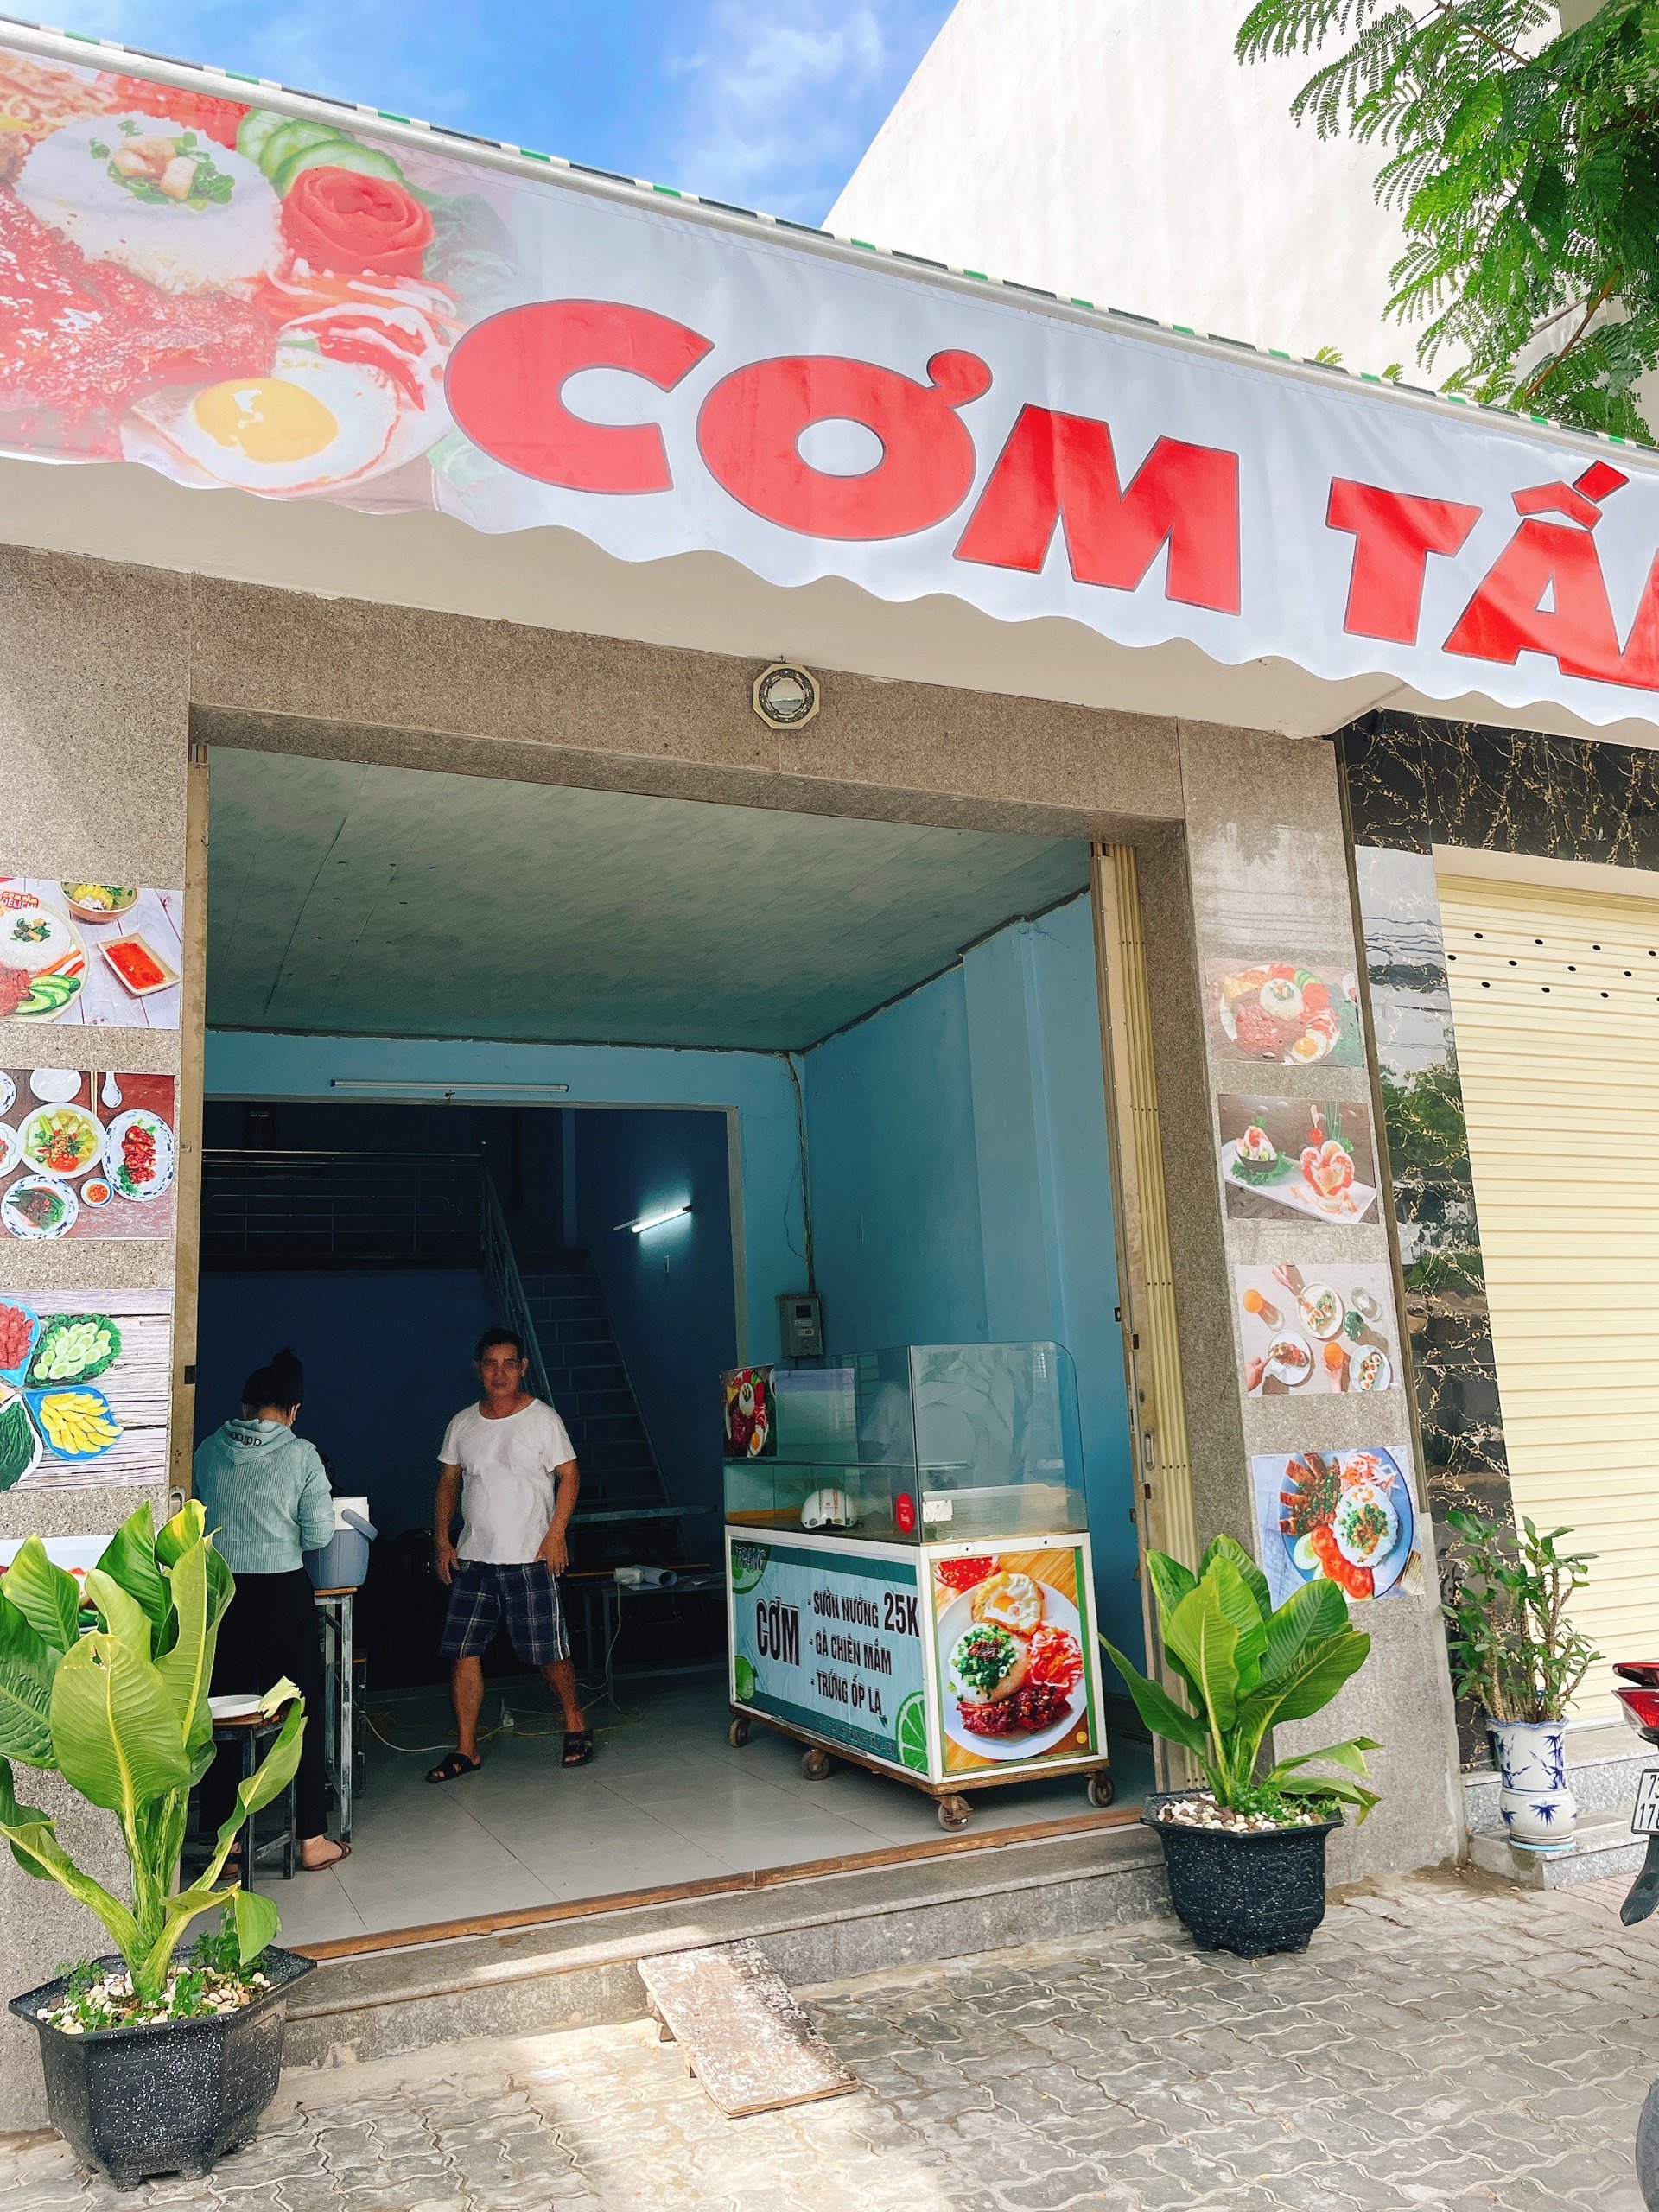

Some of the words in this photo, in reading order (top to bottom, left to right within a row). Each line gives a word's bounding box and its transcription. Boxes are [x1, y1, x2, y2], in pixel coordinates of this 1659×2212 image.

[444, 298, 1242, 617] CƠM
[1327, 459, 1659, 693] TẤ
[756, 1596, 800, 1667] CƠM
[813, 1587, 840, 1619] SƯỜN
[842, 1594, 879, 1628] NƯỚNG
[883, 1592, 920, 1637] 25K
[816, 1626, 829, 1656] GÀ
[831, 1632, 861, 1666] CHIÊN
[863, 1636, 892, 1675] MẮM
[817, 1669, 849, 1705] TRỨNG
[851, 1673, 865, 1709] ỐP
[868, 1686, 882, 1715] LA
